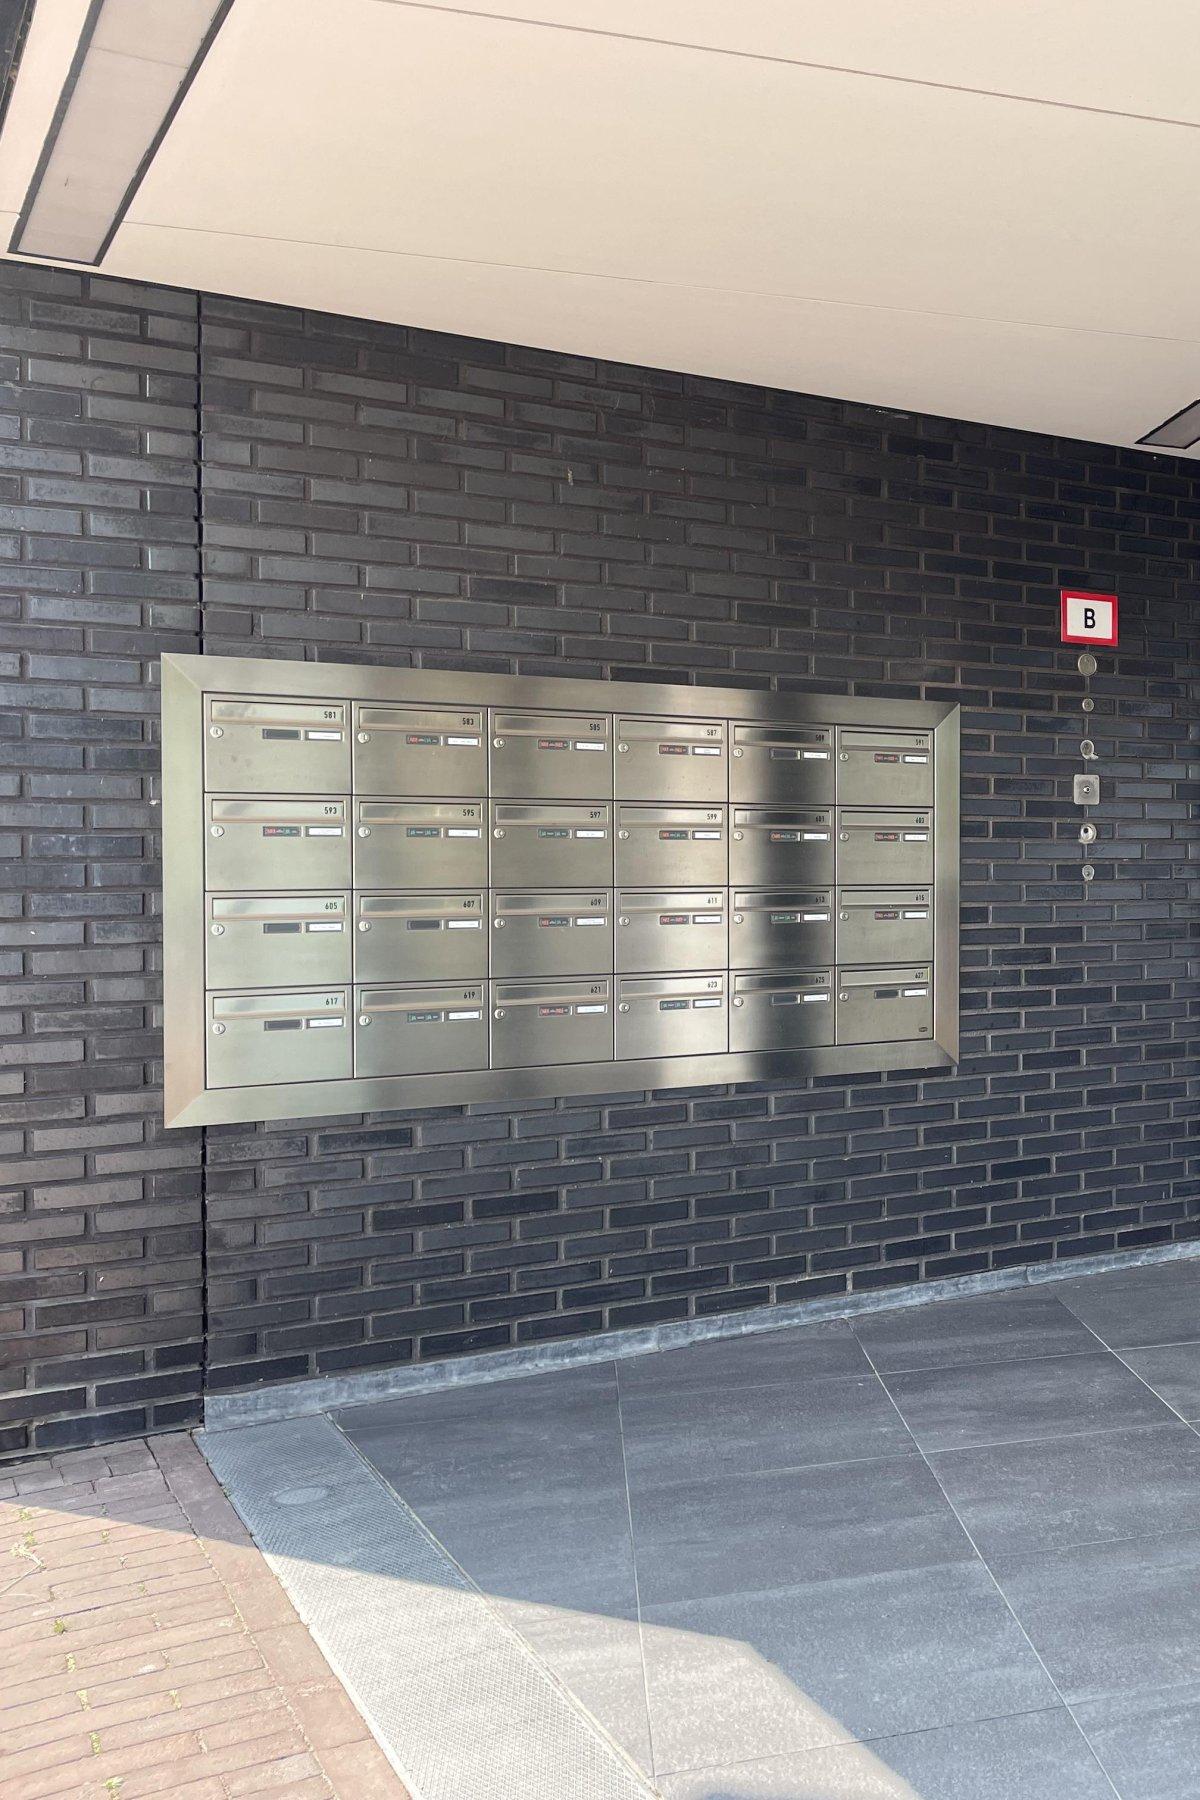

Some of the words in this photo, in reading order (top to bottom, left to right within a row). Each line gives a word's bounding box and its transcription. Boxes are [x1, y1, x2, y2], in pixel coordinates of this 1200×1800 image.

[1083, 608, 1096, 630] B
[323, 711, 336, 719] 581
[462, 717, 474, 726] 583
[589, 723, 601, 731] 585
[324, 806, 337, 815] 593
[462, 809, 475, 817] 595
[590, 811, 601, 819] 597
[325, 902, 338, 910] 605
[463, 900, 475, 908] 607
[590, 898, 602, 906] 609
[815, 976, 825, 984] 625
[590, 986, 601, 994] 621
[463, 991, 476, 1000] 619
[325, 998, 338, 1006] 617
